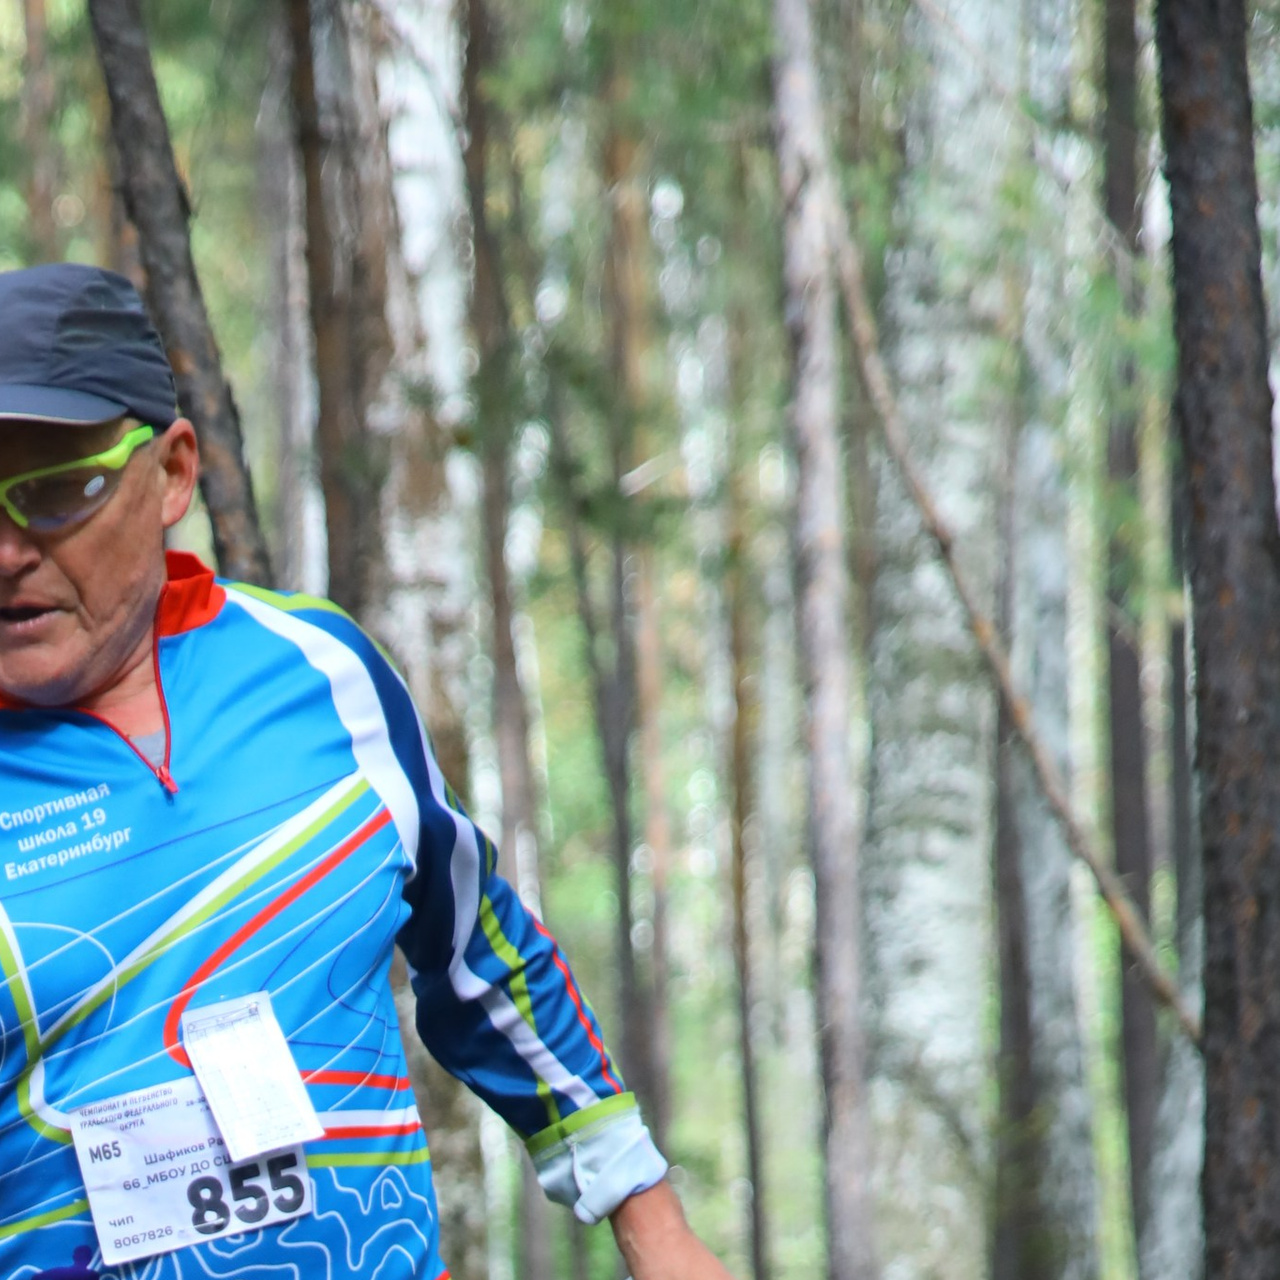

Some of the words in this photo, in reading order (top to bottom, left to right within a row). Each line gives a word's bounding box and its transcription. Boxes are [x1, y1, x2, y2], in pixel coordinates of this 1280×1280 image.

[17, 821, 77, 853] школа
[81, 808, 107, 831] 19
[4, 827, 132, 881] Екатеринбург
[80, 1101, 120, 1117] ЧЕМПИОНАТ
[144, 1142, 205, 1165] Шафиков
[207, 1137, 224, 1148] Ра
[123, 1166, 186, 1191] 66_МБОУ
[190, 1160, 210, 1175] ДО
[187, 1152, 305, 1235] 855
[109, 1215, 134, 1228] чип
[114, 1225, 173, 1249] 8067826
